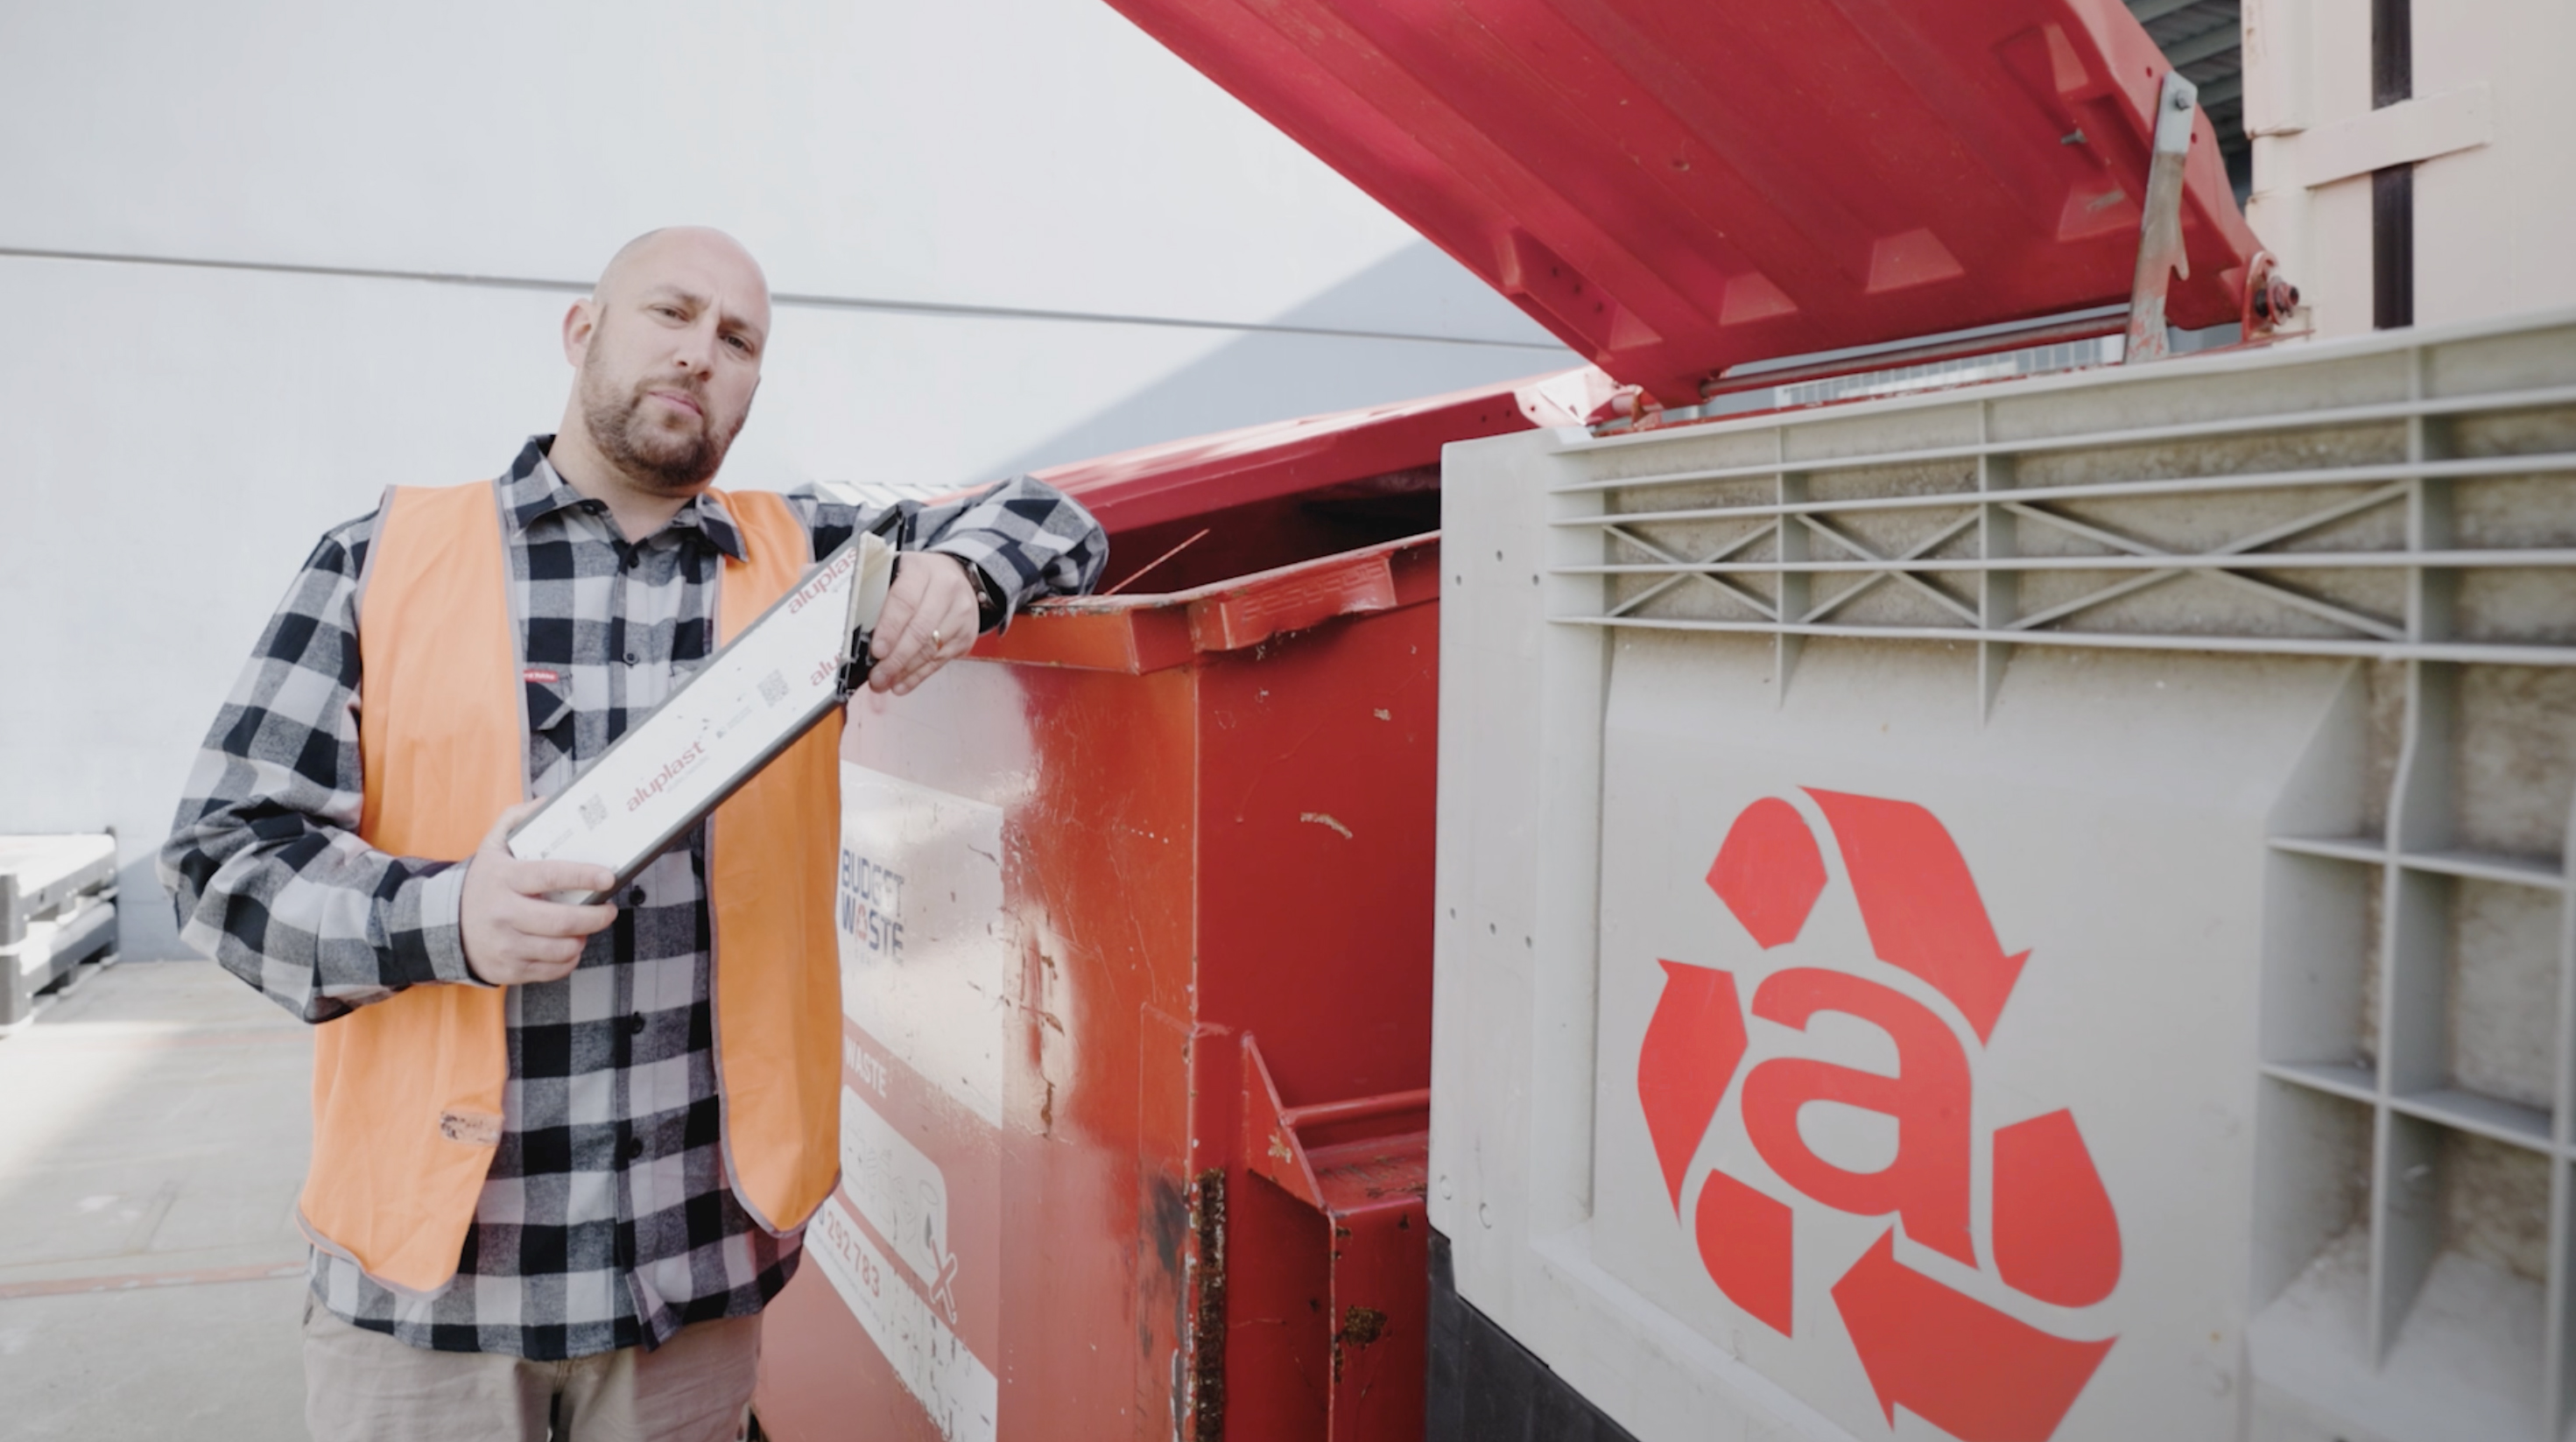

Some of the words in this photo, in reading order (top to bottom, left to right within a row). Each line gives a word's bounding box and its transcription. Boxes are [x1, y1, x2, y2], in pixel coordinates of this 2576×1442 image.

[788, 547, 857, 615] aluplas
[626, 741, 706, 812] aluplast
[844, 1034, 887, 1099] WASTE
